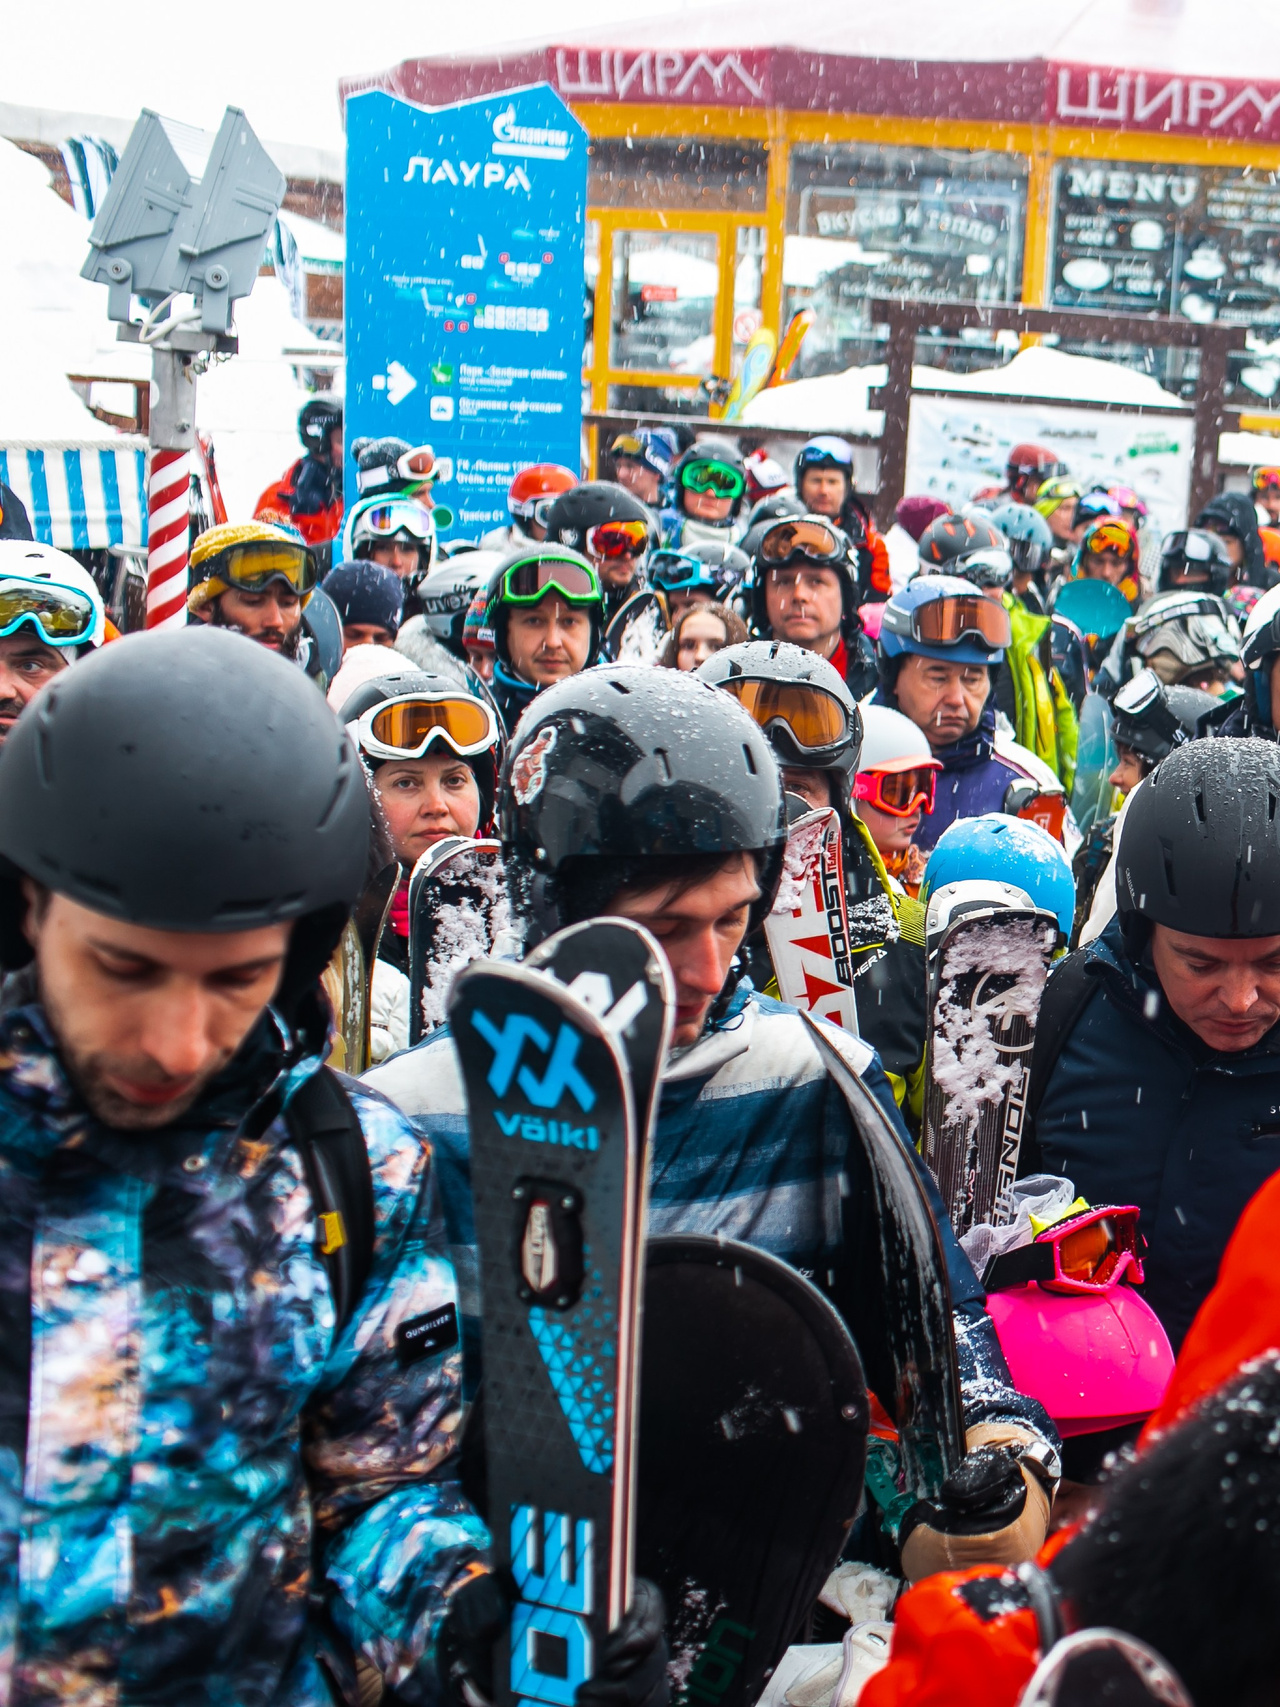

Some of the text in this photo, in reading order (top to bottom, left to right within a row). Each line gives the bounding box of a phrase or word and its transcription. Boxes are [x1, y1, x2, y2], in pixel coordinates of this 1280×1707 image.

[403, 156, 532, 192] ЛАУРА
[1067, 168, 1199, 206] MENU
[405, 1314, 450, 1339] QUIKSILVER
